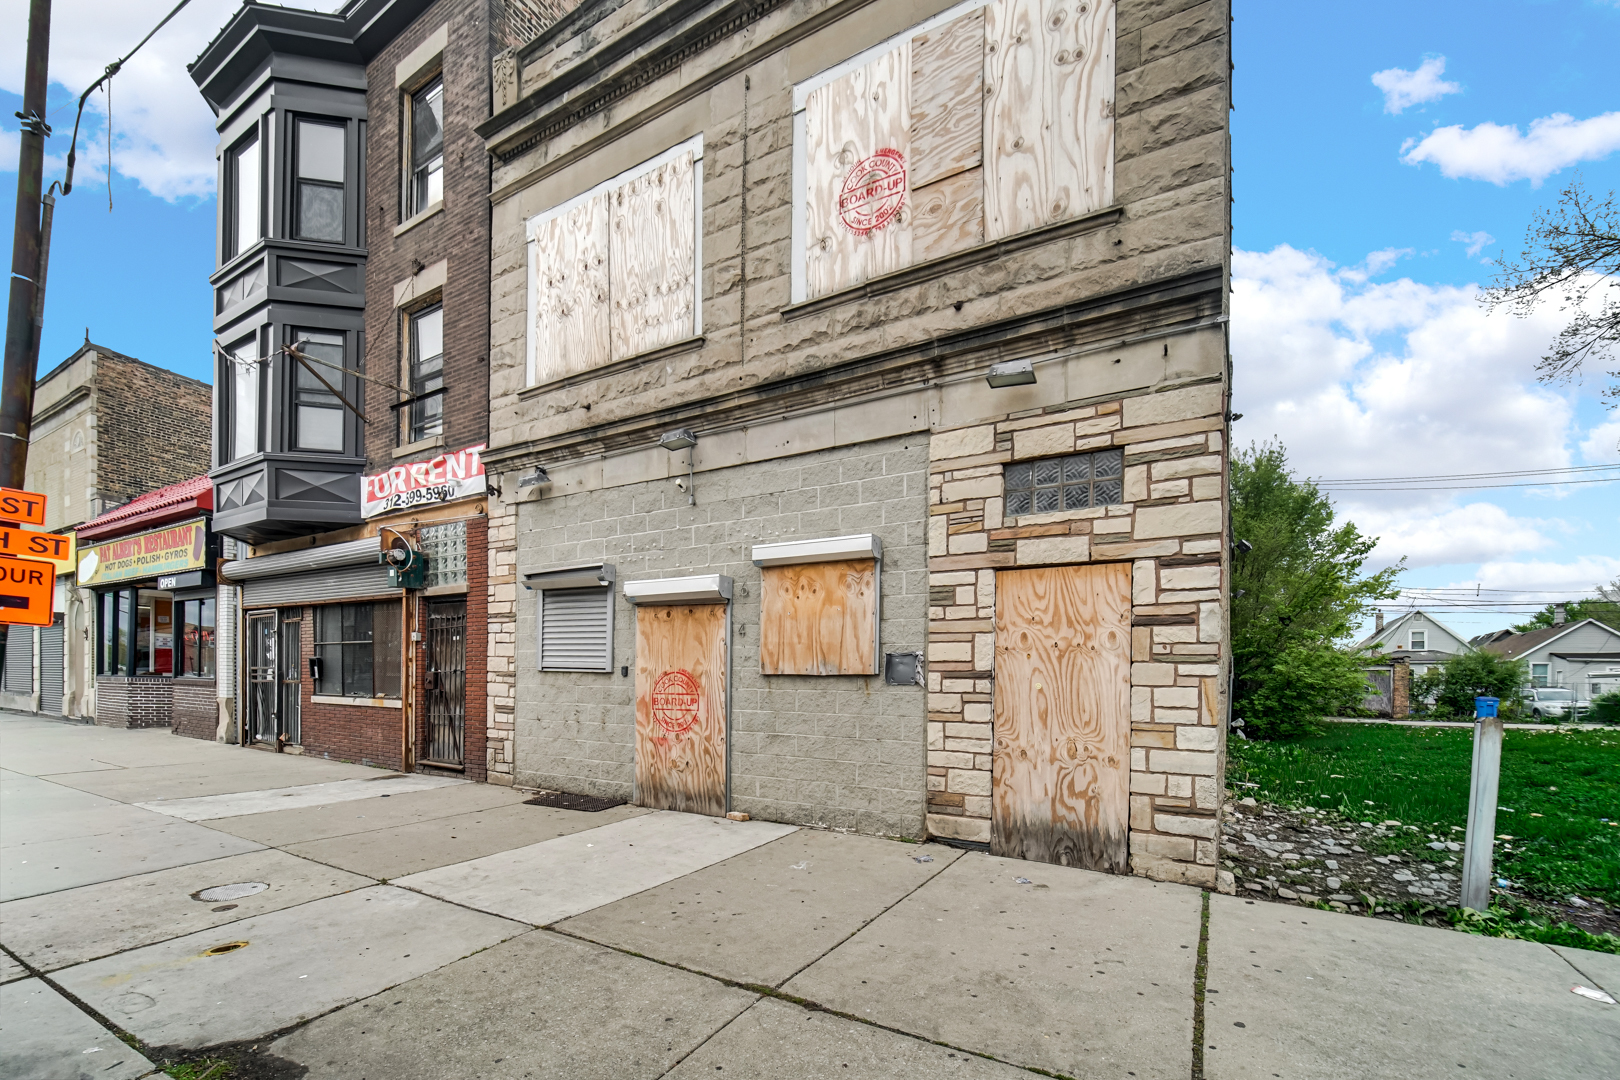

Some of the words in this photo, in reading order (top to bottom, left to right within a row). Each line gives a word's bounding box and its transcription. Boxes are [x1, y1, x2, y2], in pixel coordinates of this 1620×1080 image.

[846, 164, 868, 190] COOK
[868, 159, 898, 174] COUNTY
[841, 177, 903, 208] BOARD-UP
[851, 216, 872, 227] SINCE
[408, 446, 486, 489] RENT
[0, 497, 39, 517] ST
[28, 536, 67, 556] ST
[112, 537, 142, 560] ALBERT'S
[143, 525, 193, 554] RESTAURANT
[104, 562, 117, 572] HOT
[117, 559, 133, 569] DOGS
[136, 553, 160, 565] POLISH
[164, 548, 188, 561] GYROS
[160, 577, 176, 588] OPEN
[653, 697, 698, 706] BOARD-UP
